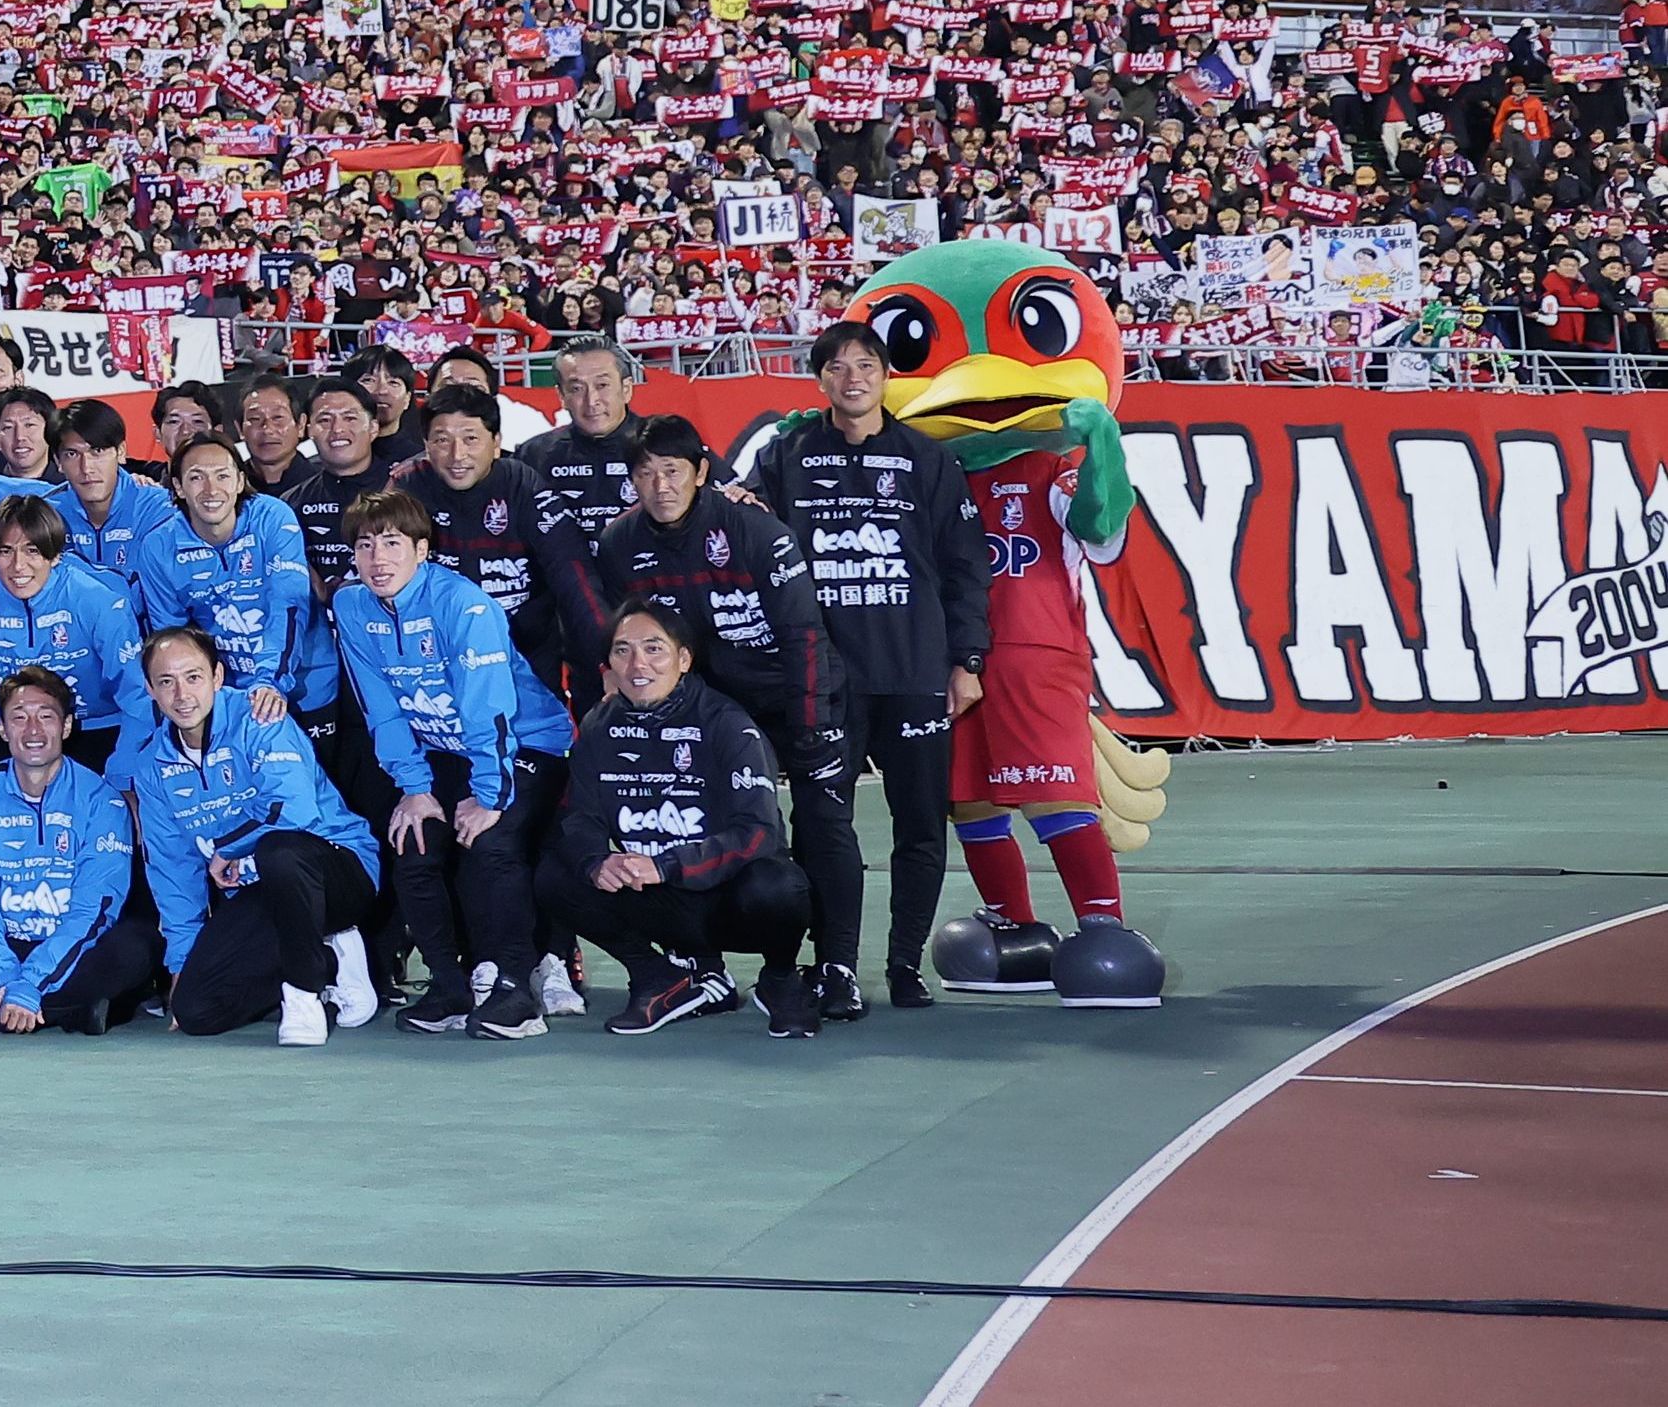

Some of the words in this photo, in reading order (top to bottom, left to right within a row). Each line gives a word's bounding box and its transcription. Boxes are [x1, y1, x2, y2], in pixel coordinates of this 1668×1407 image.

[1366, 50, 1380, 67] 5
[812, 556, 911, 580] 岡山ガス
[816, 583, 910, 607] 中国銀行
[987, 764, 1076, 785] 山陽新聞
